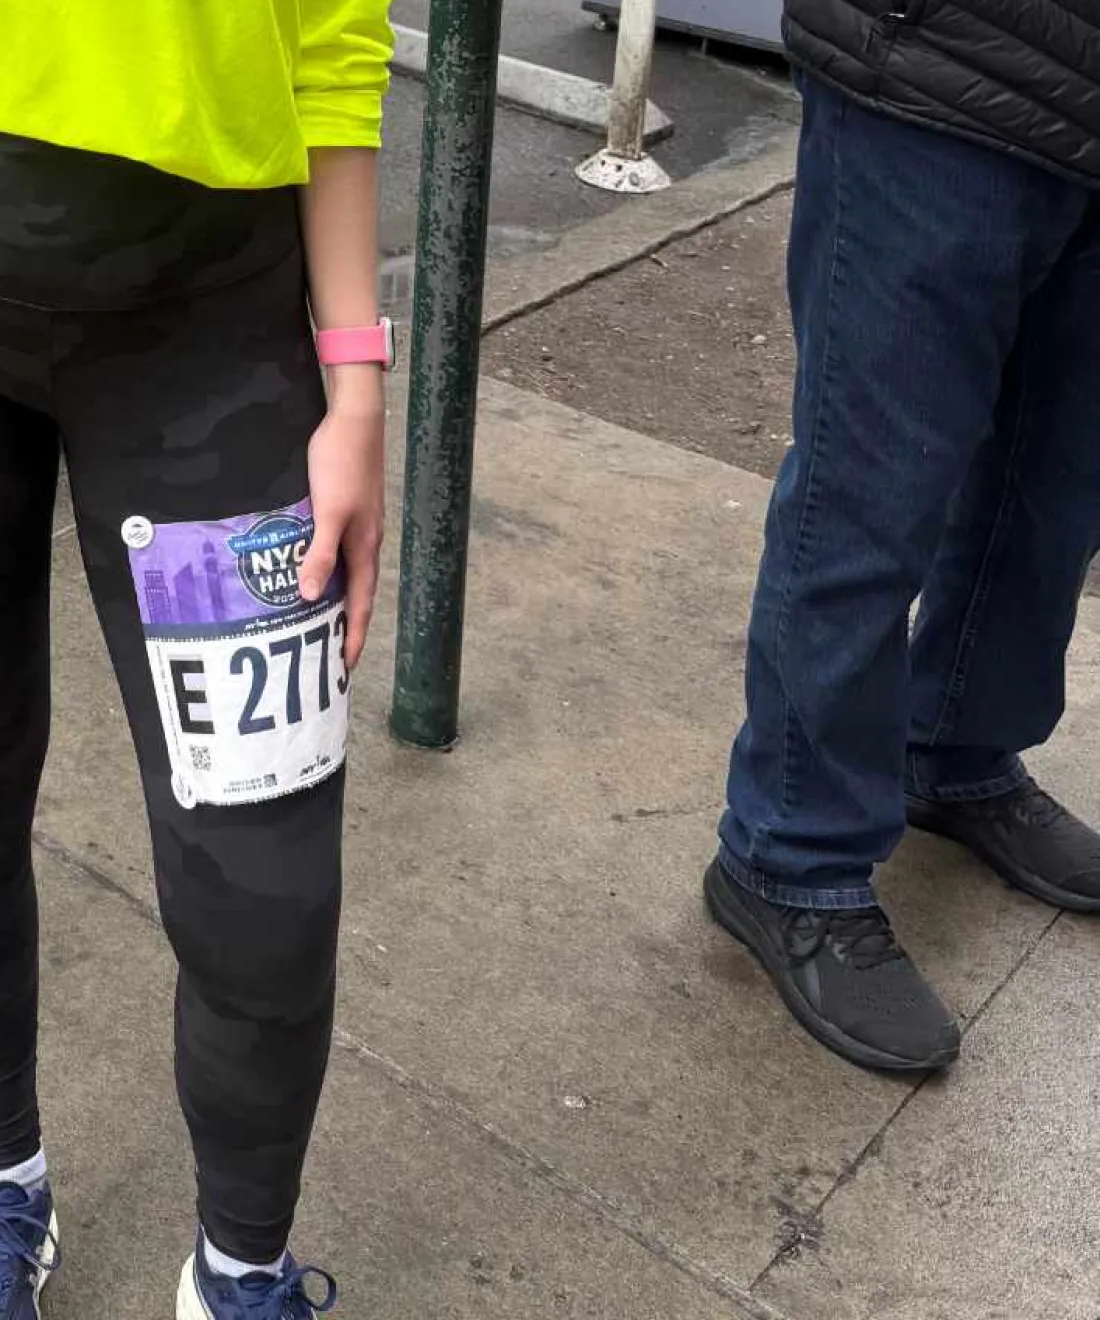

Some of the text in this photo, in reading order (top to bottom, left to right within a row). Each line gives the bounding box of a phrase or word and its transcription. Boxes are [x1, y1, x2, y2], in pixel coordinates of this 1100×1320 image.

[251, 539, 306, 575] NYC
[259, 566, 299, 593] HAL
[169, 659, 215, 735] E
[229, 609, 350, 736] 2773
